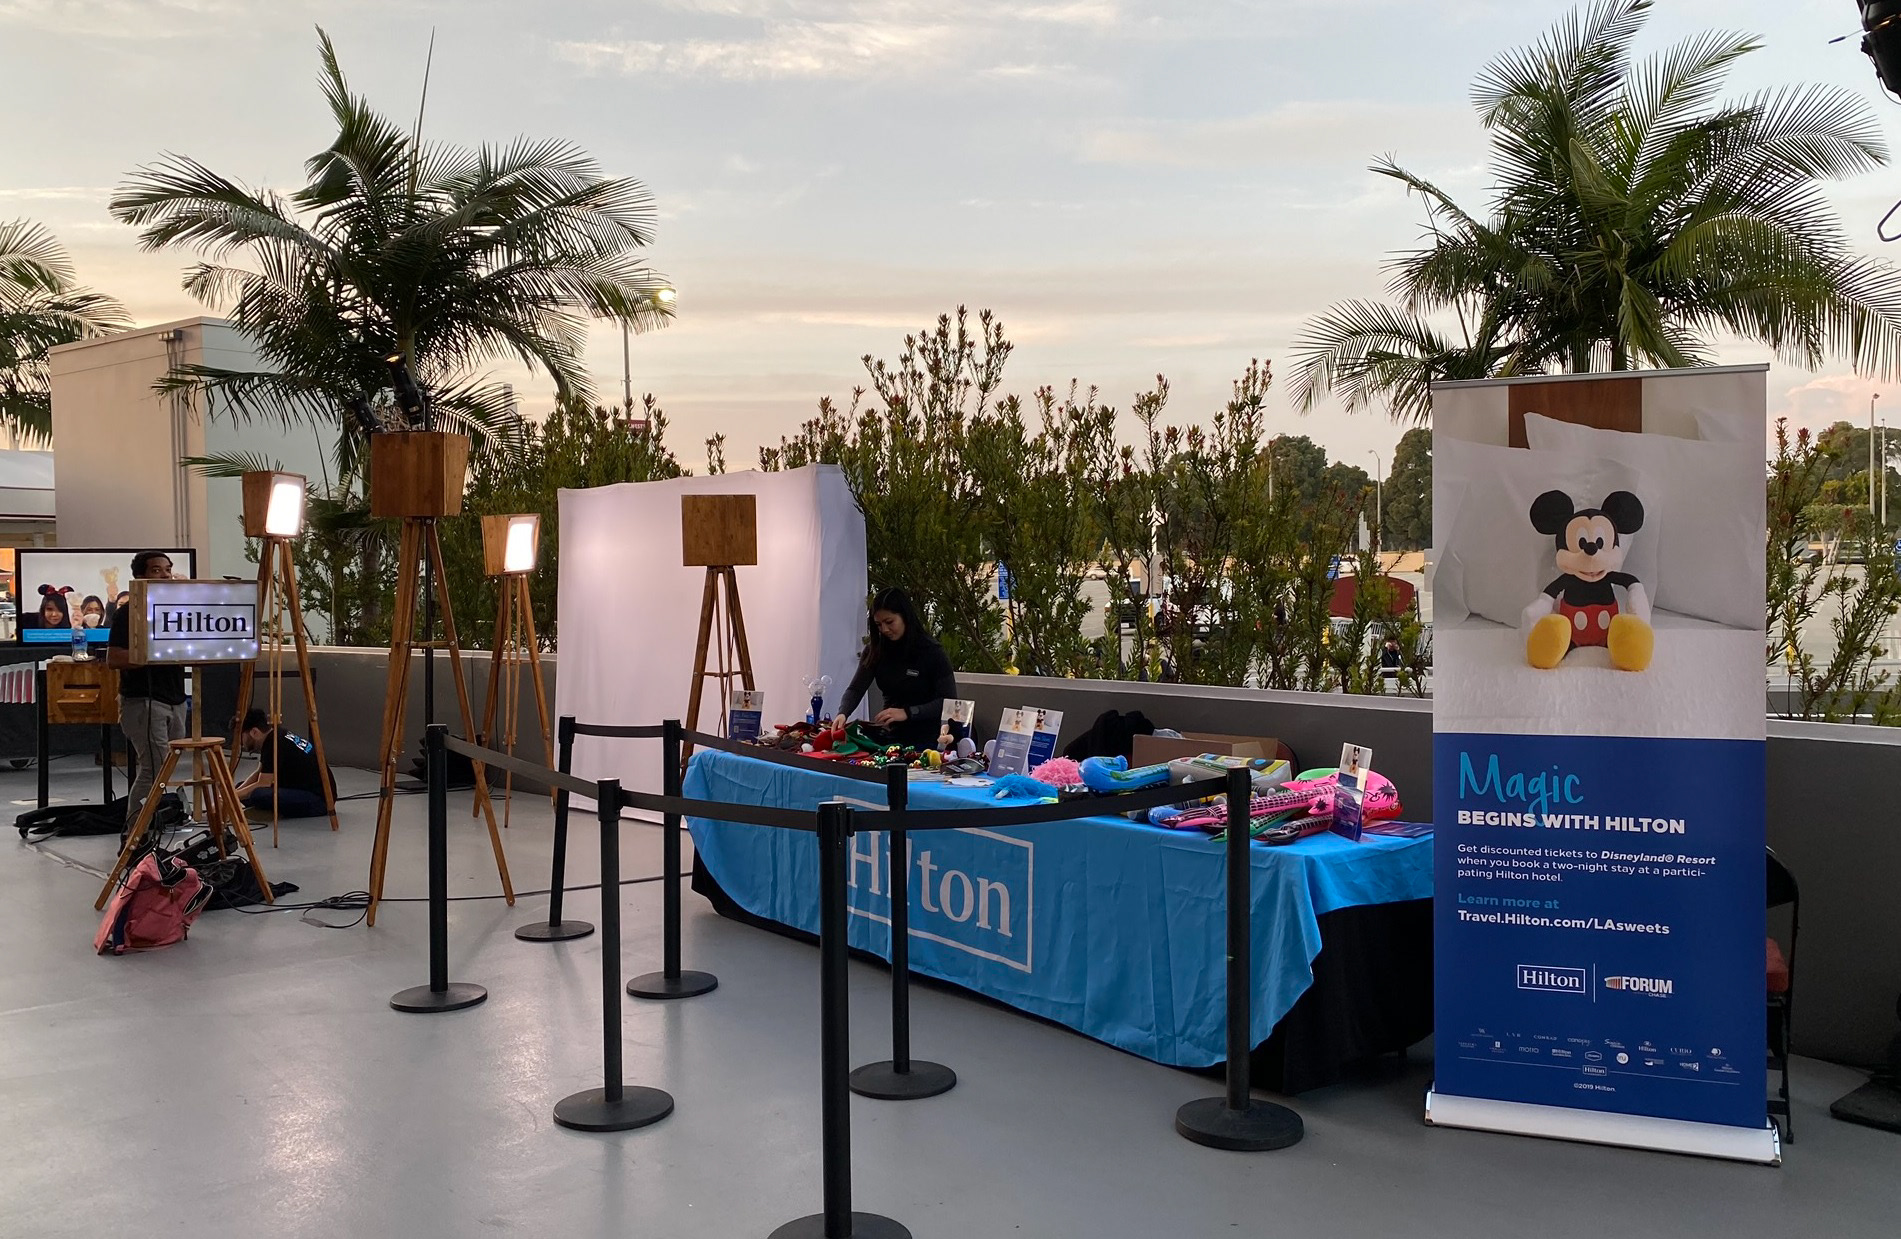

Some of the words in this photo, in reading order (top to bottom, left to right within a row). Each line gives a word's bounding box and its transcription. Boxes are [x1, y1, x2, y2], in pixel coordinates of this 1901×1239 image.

[161, 611, 247, 632] Hilton
[1459, 751, 1584, 827] Magic
[1457, 810, 1536, 828] BEGINS
[1541, 813, 1600, 830] WITH
[1605, 816, 1685, 834] HILTON
[1457, 843, 1478, 853] Get
[1480, 845, 1542, 856] discounted
[1544, 848, 1583, 858] tickets
[1586, 850, 1598, 859] to
[1600, 850, 1674, 863] Disneyland®
[1677, 854, 1716, 865] Resort
[1457, 856, 1487, 865] when
[1489, 859, 1510, 868] you
[1512, 859, 1541, 869] book
[1542, 861, 1550, 869] a
[1552, 861, 1608, 873] two-night
[1611, 865, 1636, 875] stay
[1638, 866, 1650, 875] at
[1653, 867, 1660, 875] a
[1662, 868, 1706, 877] partici-
[1457, 869, 1493, 880] pating
[1495, 870, 1529, 880] Hilton
[1531, 871, 1563, 882] hotel.
[848, 830, 1013, 938] Hton
[1458, 892, 1499, 906] Learn
[1502, 897, 1541, 908] more
[1544, 898, 1560, 909] at
[1457, 909, 1670, 935] Travel.Hilton.com/LAsweets
[1522, 969, 1580, 988] Hilton
[1621, 976, 1673, 994] FORUM
[1584, 1066, 1605, 1075] Hilton
